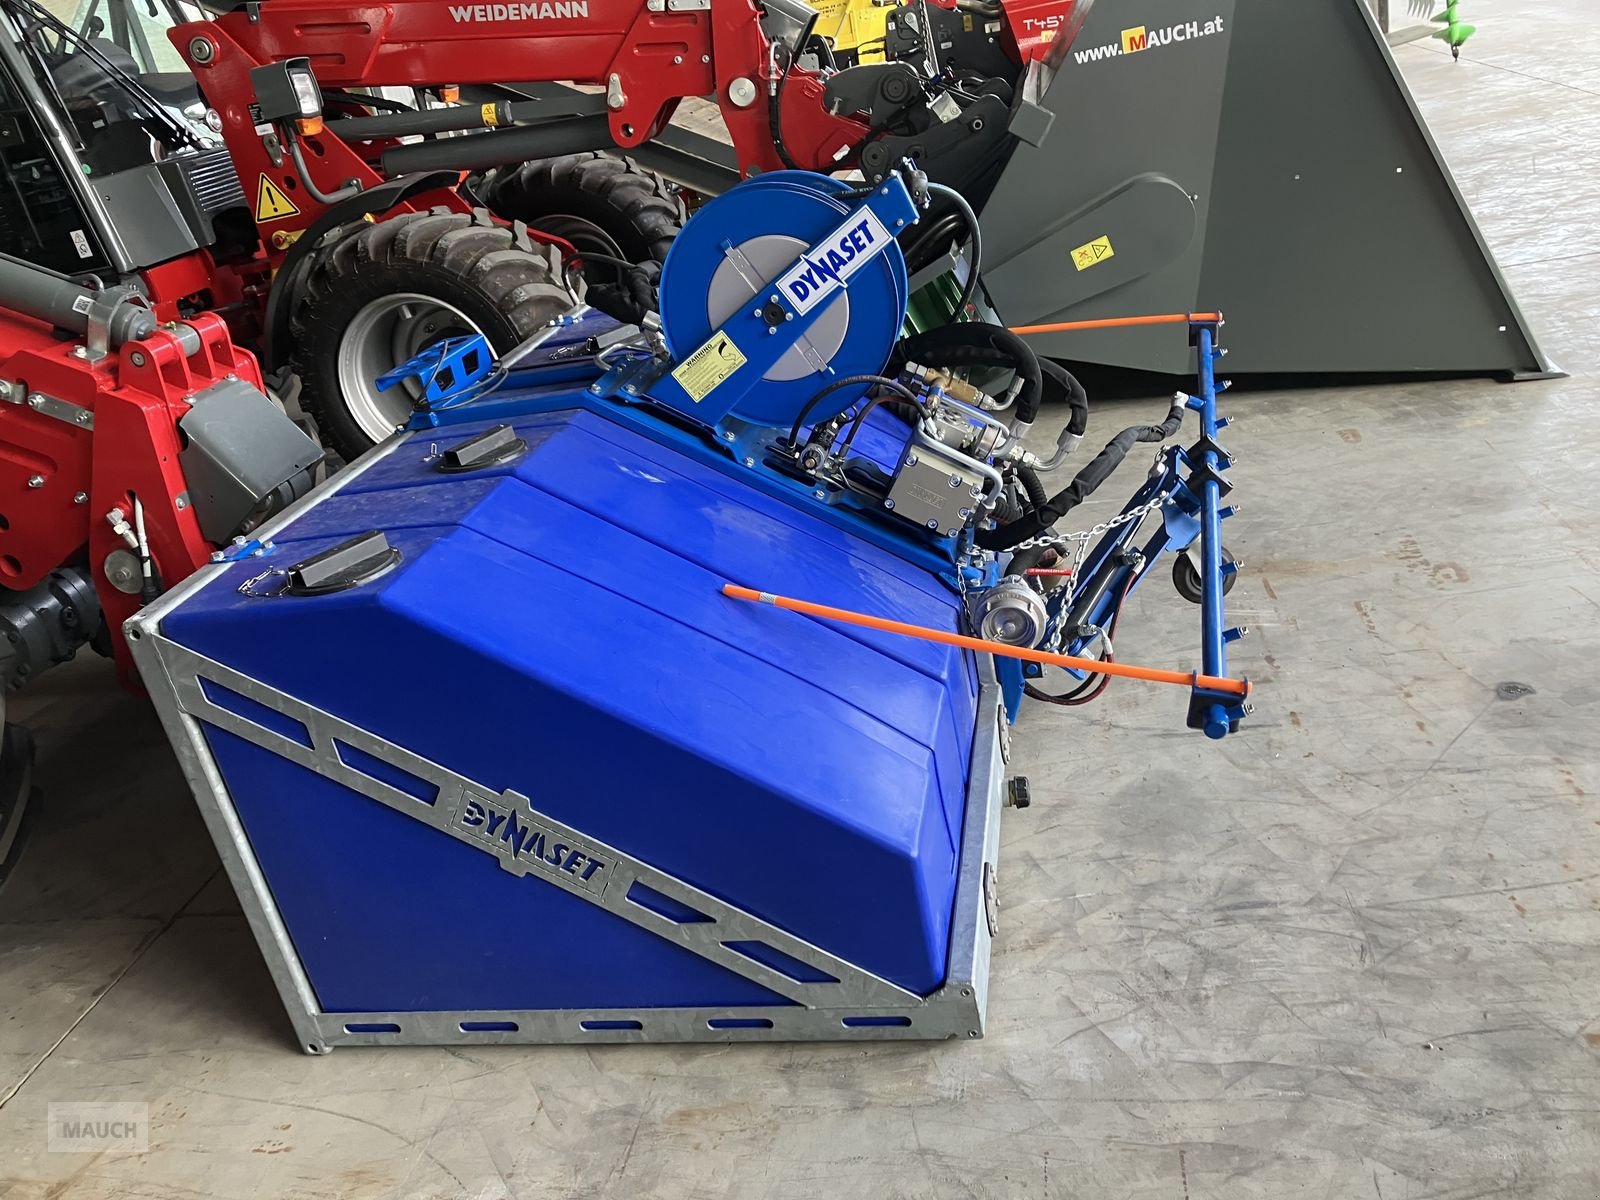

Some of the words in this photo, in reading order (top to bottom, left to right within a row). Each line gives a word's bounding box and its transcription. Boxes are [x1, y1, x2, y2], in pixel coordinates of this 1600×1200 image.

[448, 1, 589, 22] WEIDEMANN
[1074, 15, 1224, 65] www.MAUCH.at
[788, 218, 875, 303] DYNASET
[685, 343, 713, 367] WARNING
[461, 799, 606, 883] DYNASET
